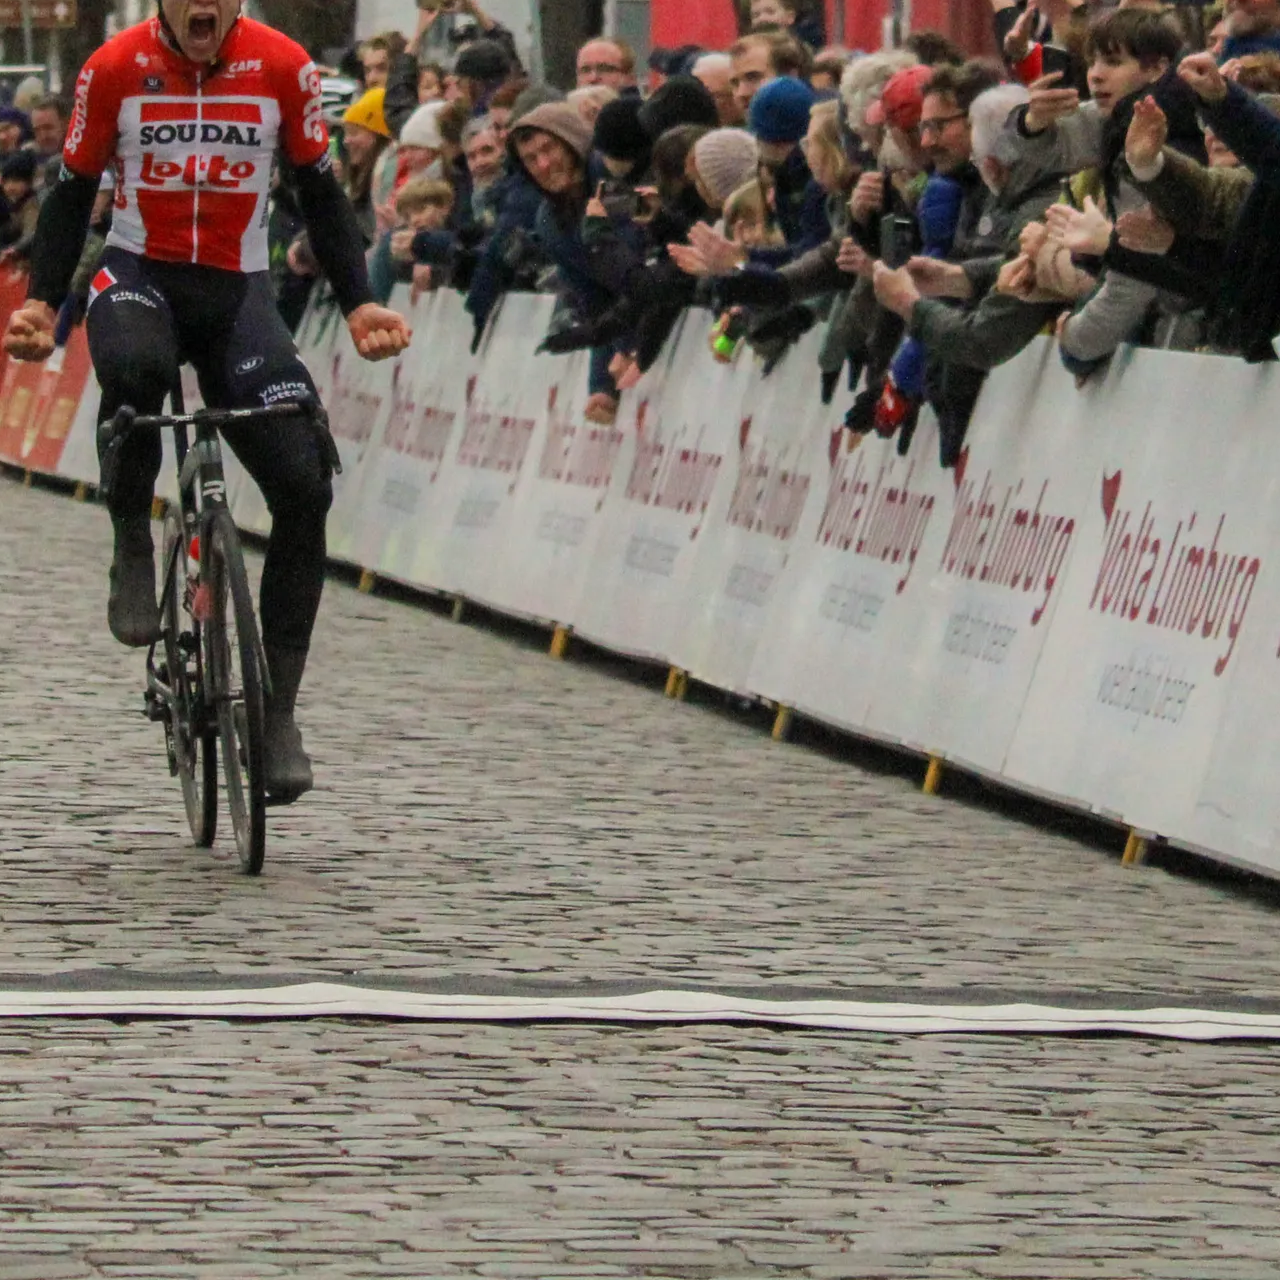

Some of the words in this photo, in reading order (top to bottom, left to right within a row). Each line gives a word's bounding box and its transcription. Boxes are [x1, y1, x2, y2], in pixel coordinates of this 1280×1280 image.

[65, 69, 95, 155] SOUDAL
[140, 123, 261, 147] SOUDAL
[1089, 500, 1160, 621] Volta
[1147, 511, 1260, 677] Limburg
